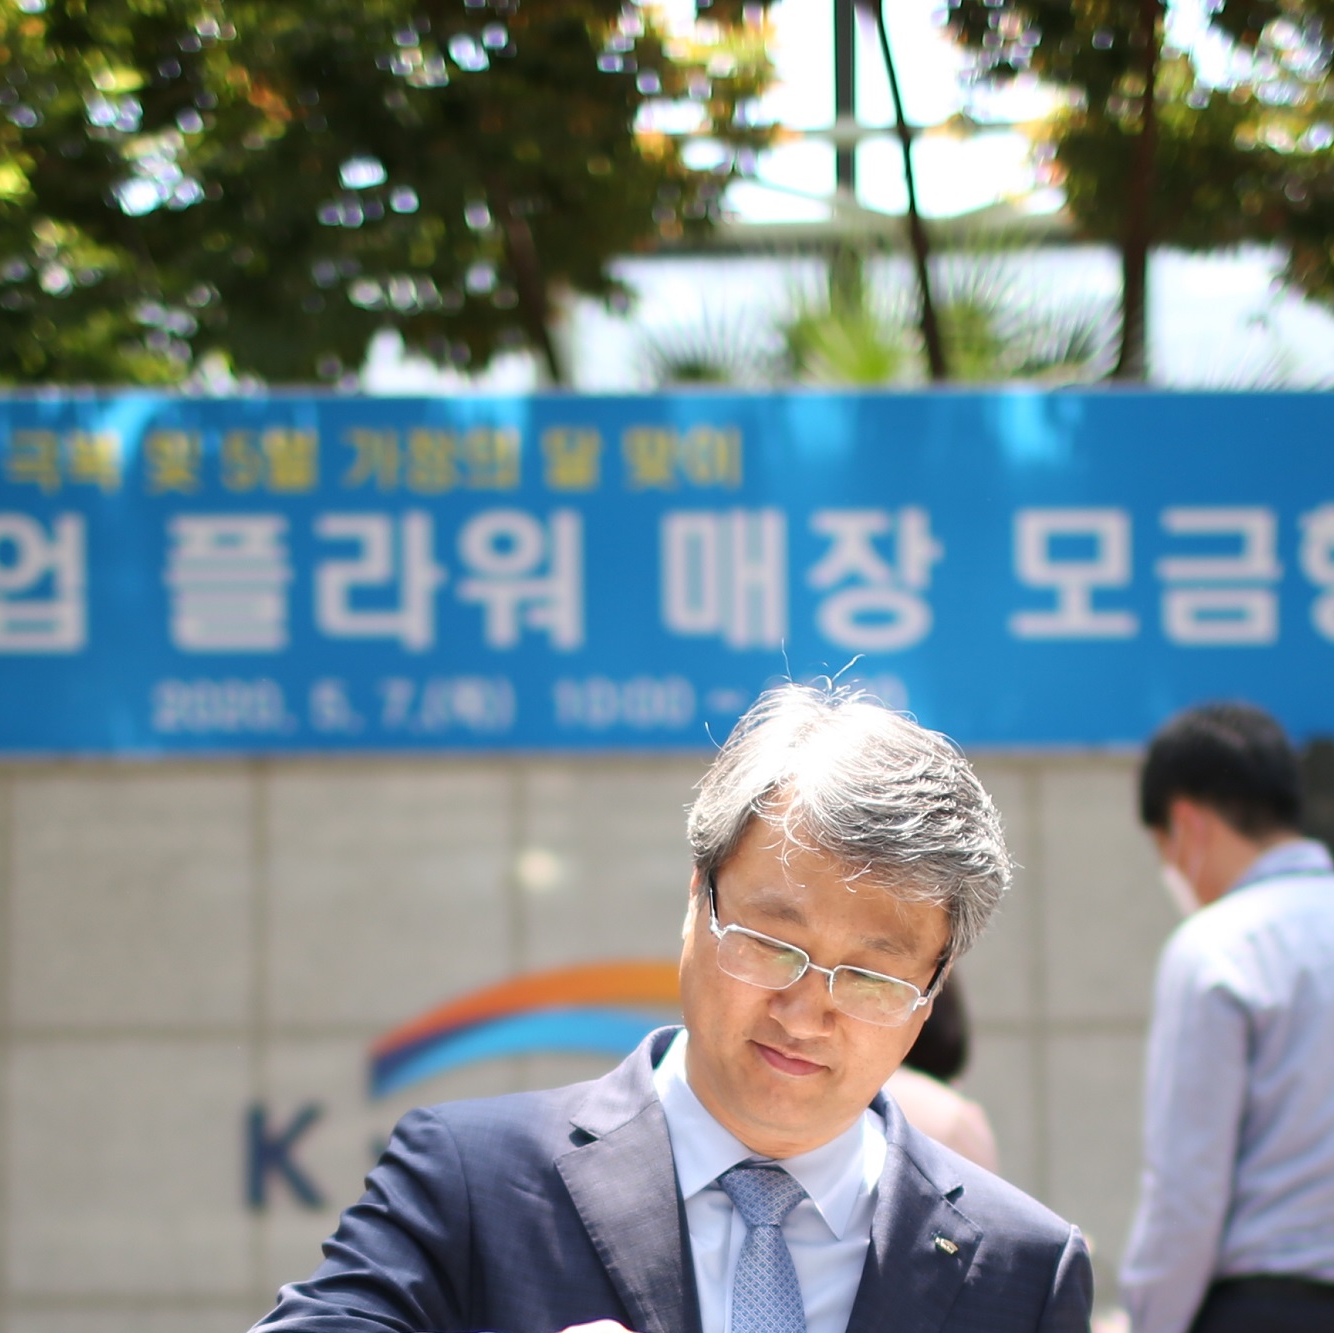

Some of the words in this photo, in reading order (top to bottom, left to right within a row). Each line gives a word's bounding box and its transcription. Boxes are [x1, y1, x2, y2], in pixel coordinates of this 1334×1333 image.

[345, 427, 520, 491] 가정의
[542, 427, 601, 489] 달
[622, 427, 743, 491] 맞이
[166, 511, 586, 652] 플라워
[662, 510, 943, 652] 매장
[245, 1100, 326, 1211] K
